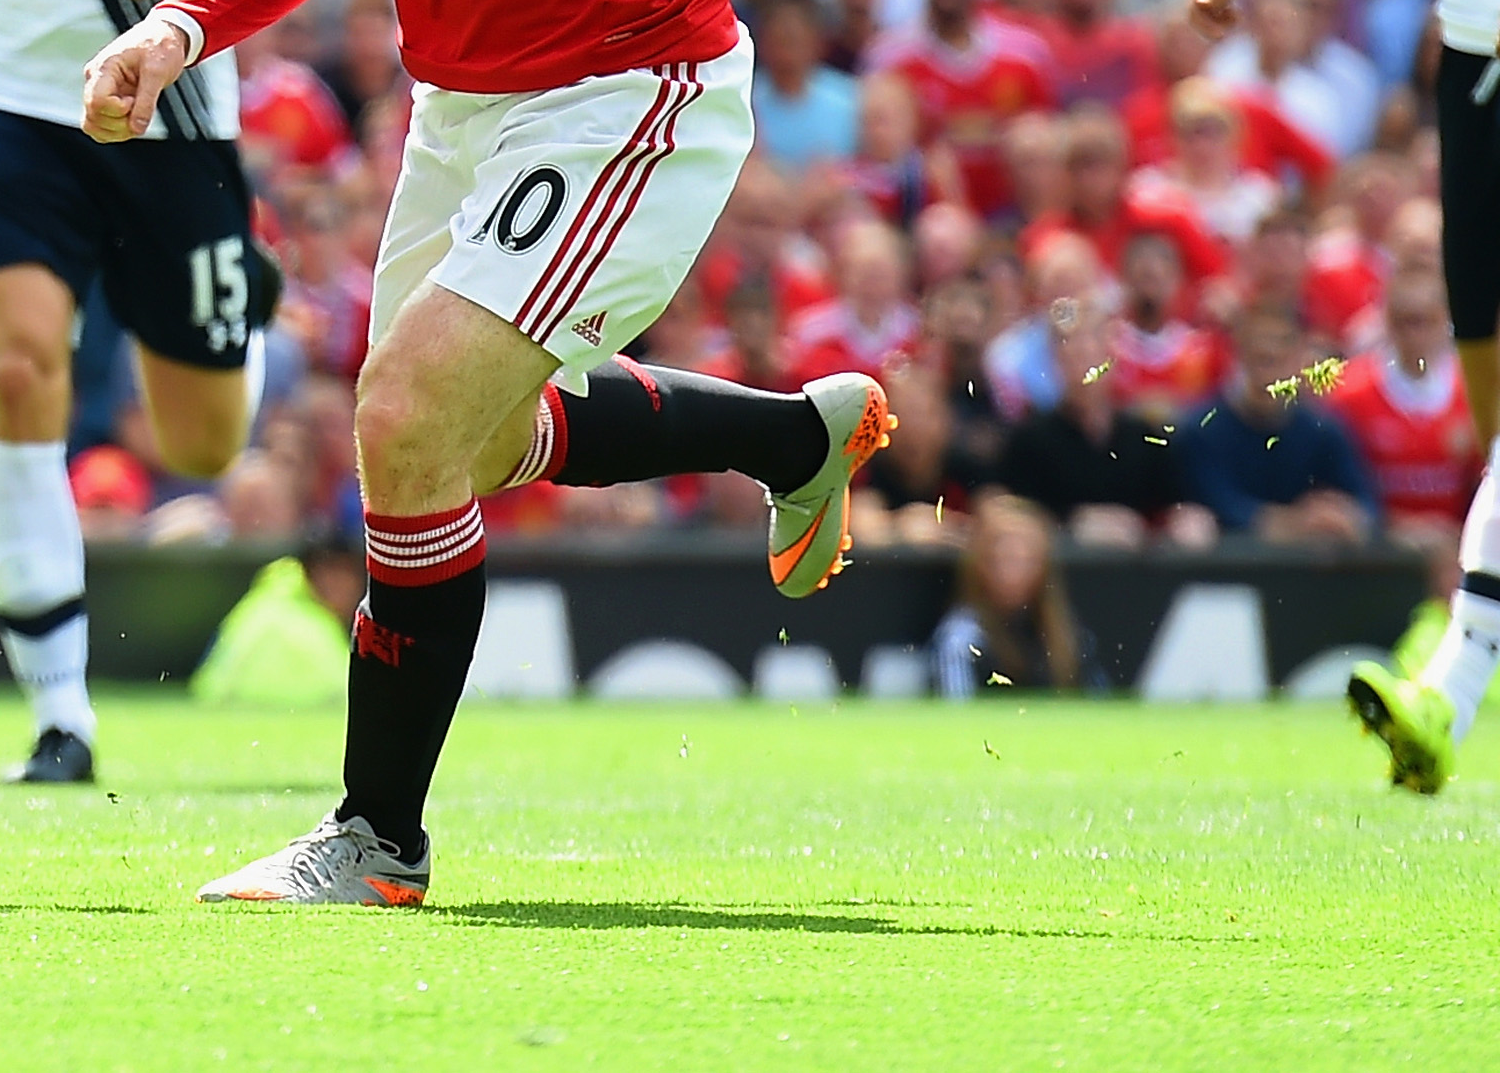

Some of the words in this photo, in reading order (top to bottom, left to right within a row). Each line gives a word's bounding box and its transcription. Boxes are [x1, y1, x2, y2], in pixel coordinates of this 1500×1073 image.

[467, 164, 570, 256] 10
[189, 235, 248, 326] 15
[571, 323, 602, 346] adidas
